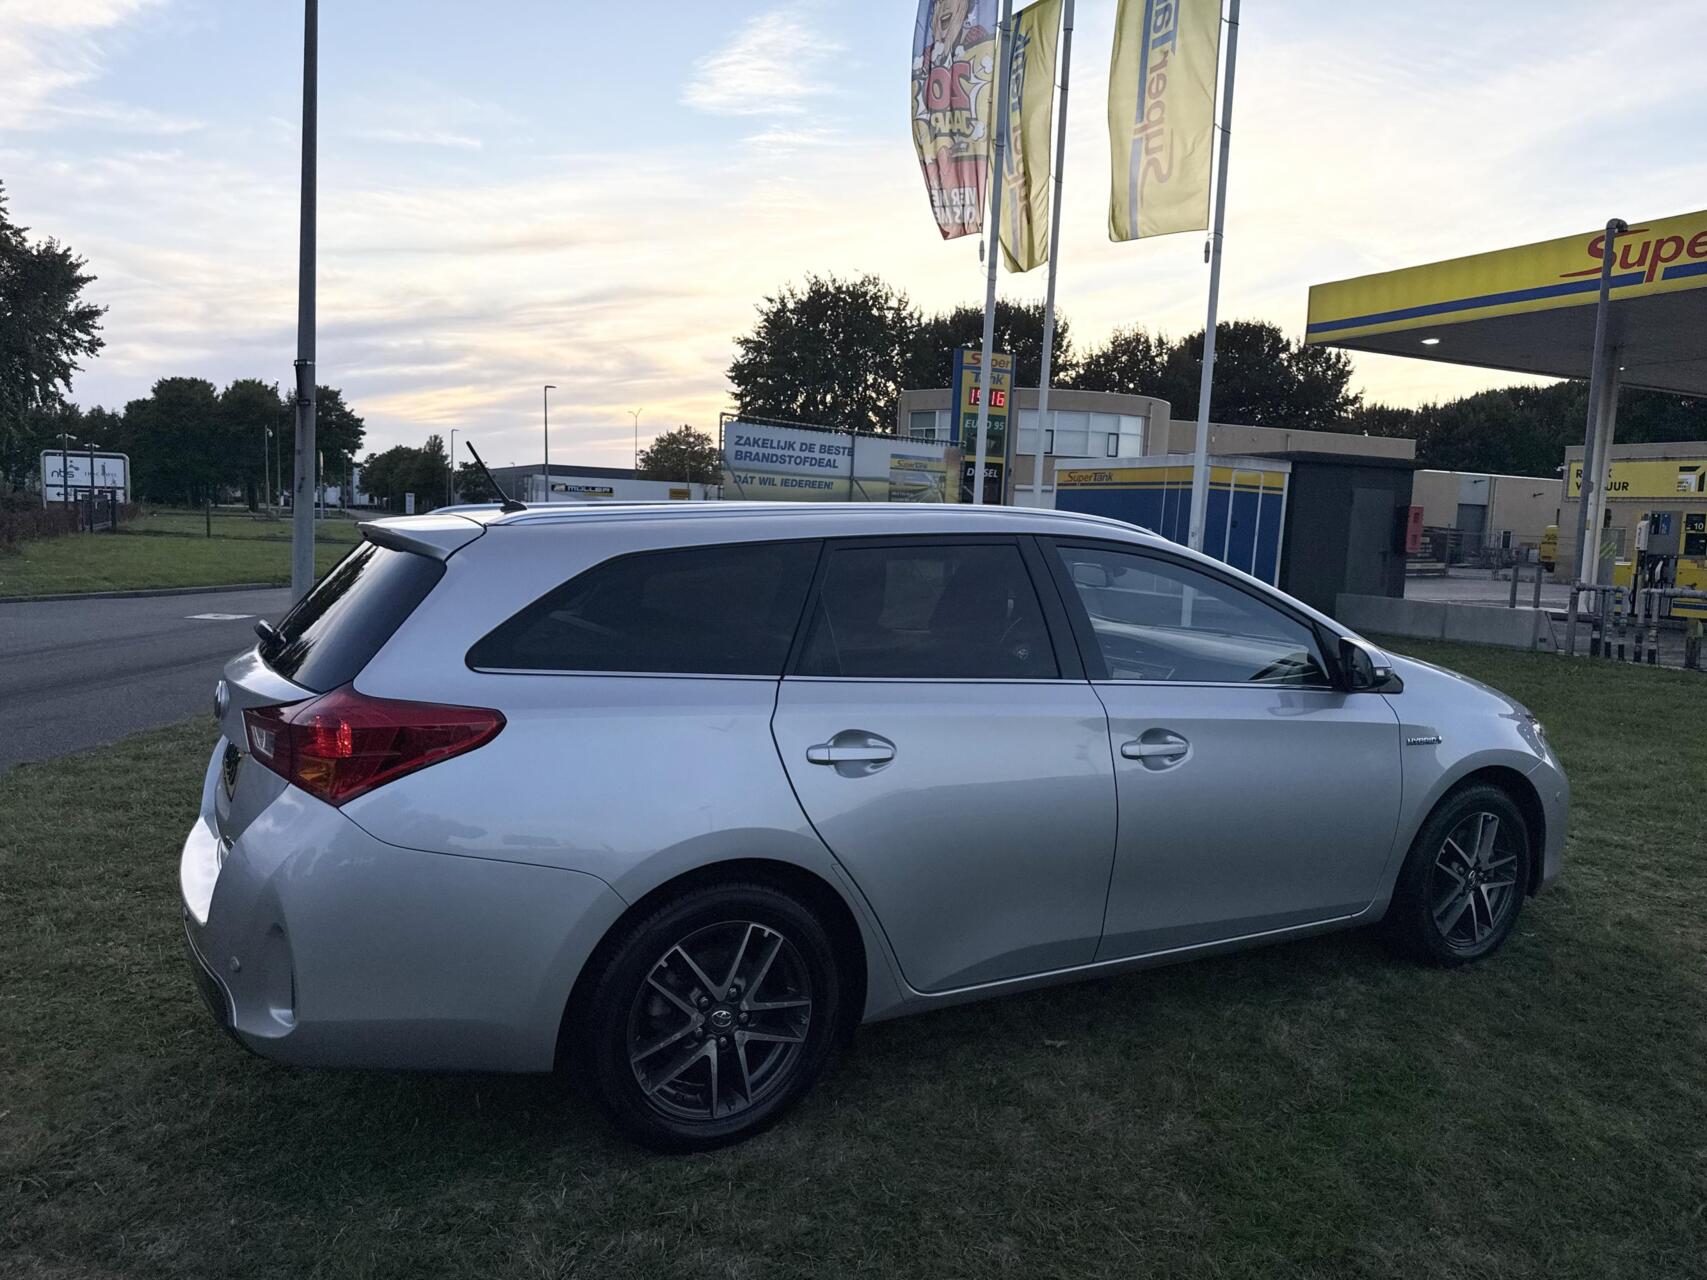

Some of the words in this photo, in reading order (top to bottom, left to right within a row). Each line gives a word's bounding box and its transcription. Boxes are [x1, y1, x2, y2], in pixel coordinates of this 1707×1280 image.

[964, 352, 1010, 369] Sper
[971, 371, 1004, 385] Tnk
[965, 419, 992, 430] EUO
[994, 420, 1005, 431] 95
[734, 435, 797, 452] ZAKELIJK
[799, 441, 817, 453] DE
[819, 443, 854, 457] BESTE
[734, 449, 839, 469] BRANDSTOFDEAL
[966, 467, 999, 479] DSEL
[758, 475, 778, 487] WIL
[780, 477, 834, 490] IEDEREEN!
[1575, 481, 1630, 492] VUUR
